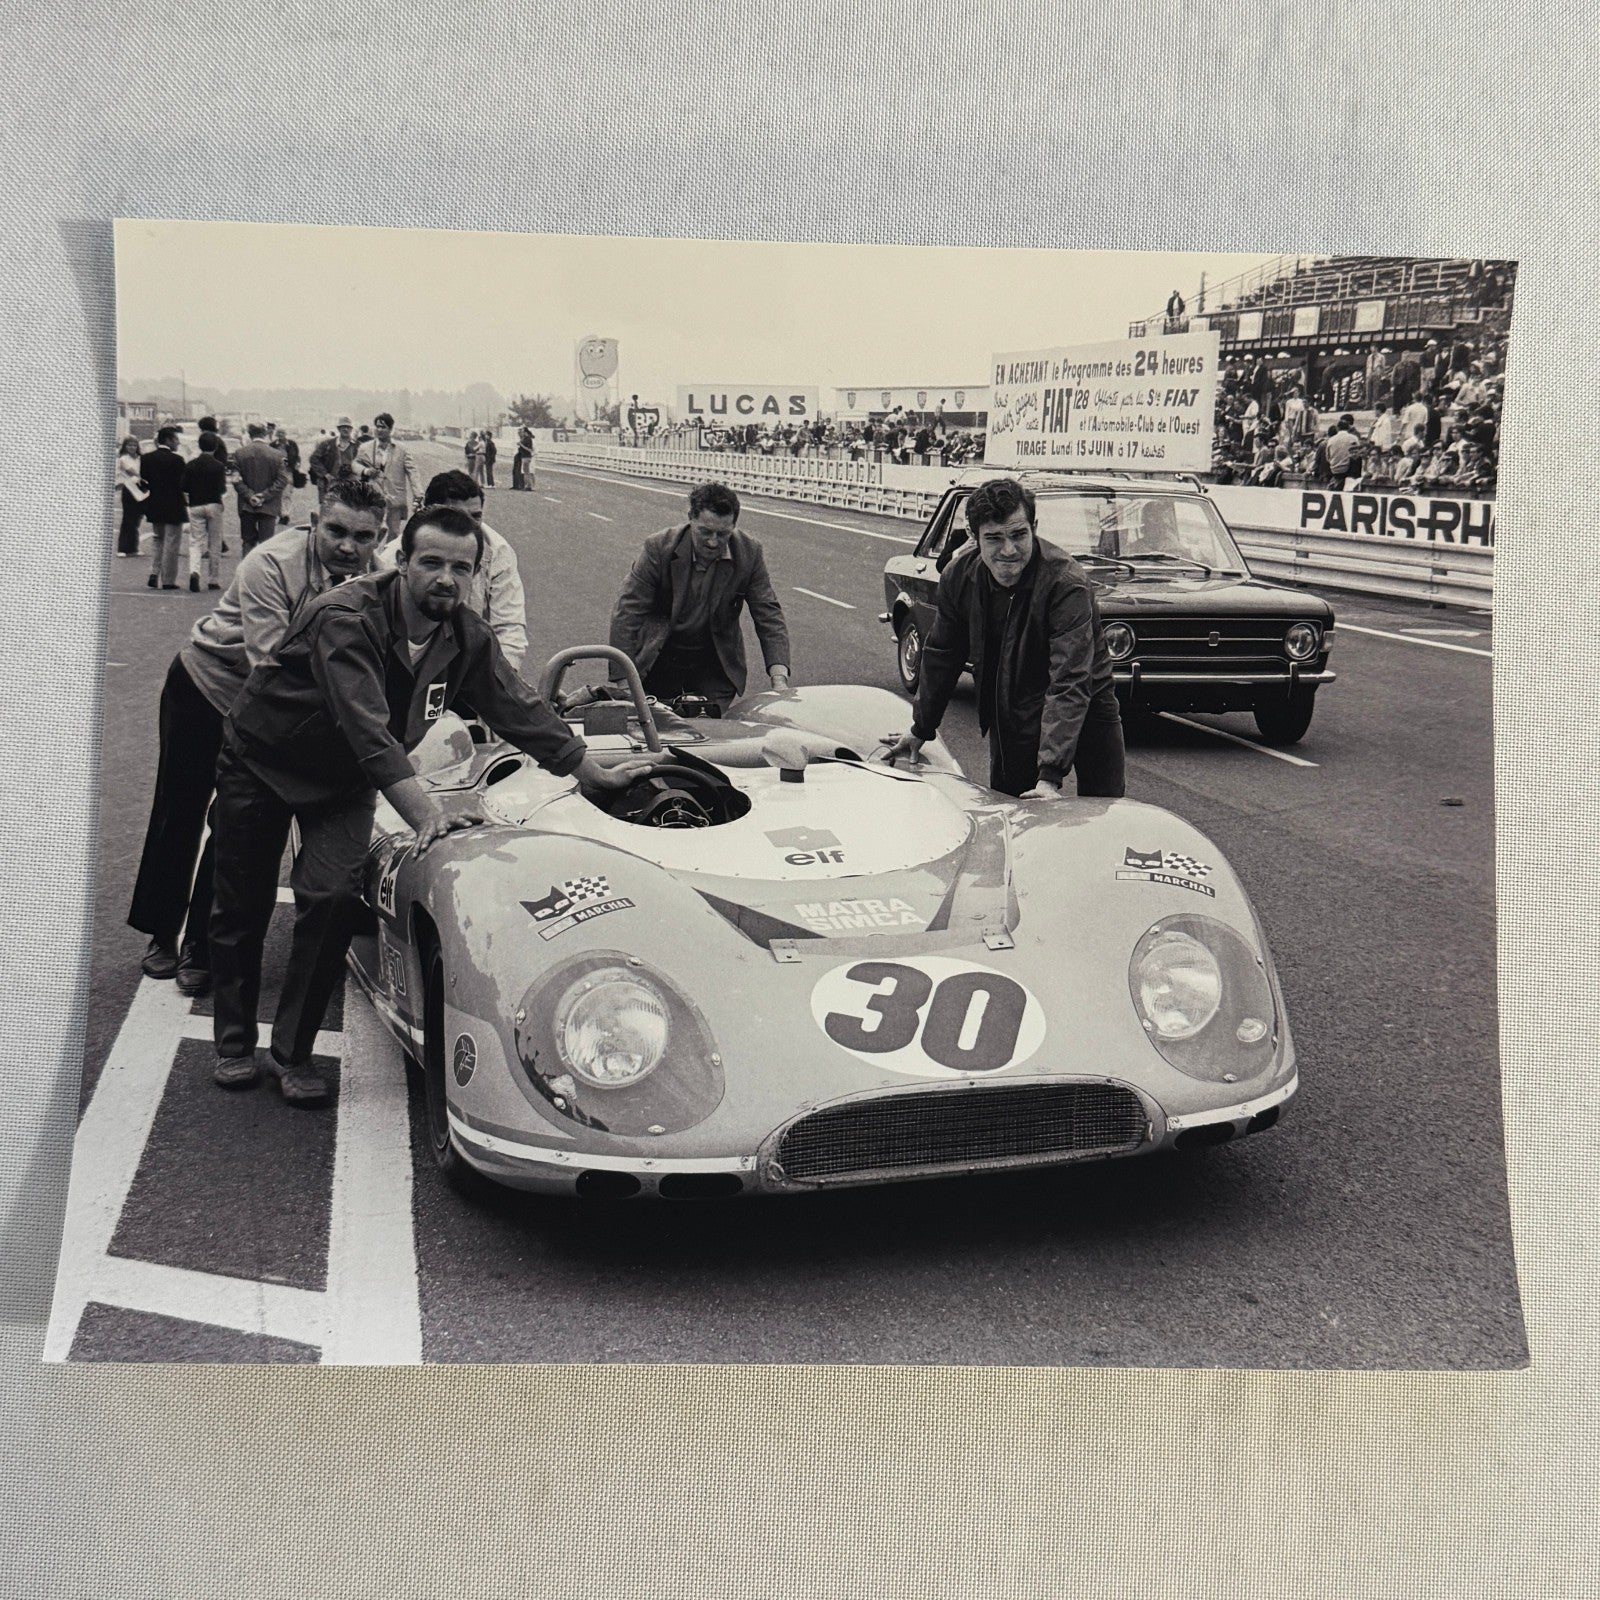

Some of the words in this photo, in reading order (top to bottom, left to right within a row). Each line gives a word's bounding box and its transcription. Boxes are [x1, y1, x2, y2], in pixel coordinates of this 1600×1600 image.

[995, 364, 1006, 385] EN
[1008, 361, 1049, 384] ACHETANT
[1052, 362, 1060, 380] le
[1062, 358, 1113, 386] Programme
[1116, 360, 1131, 377] des
[1134, 350, 1159, 376] 24
[1162, 350, 1204, 375] heures
[687, 394, 807, 416] LUCAS
[1042, 388, 1073, 434] FIAT
[1073, 389, 1090, 410] 128
[1163, 389, 1200, 407] FIAT
[635, 412, 658, 429] BP
[1079, 417, 1087, 431] et
[1157, 417, 1167, 433] de
[1169, 415, 1201, 435] l'Ouest
[1016, 440, 1047, 456] TIRAGE
[1051, 440, 1073, 456] Lundi
[1076, 440, 1087, 456] 15
[1088, 440, 1114, 457] JUIN
[1127, 441, 1139, 458] 17
[1300, 492, 1494, 547] PARIS-RH
[785, 850, 845, 866] elf
[380, 875, 394, 910] elf
[1153, 873, 1214, 896] MARCHAL
[575, 899, 632, 922] MARCHAL
[794, 898, 916, 918] MATRA
[805, 912, 928, 931] SIMCA
[824, 961, 1028, 1072] 30
